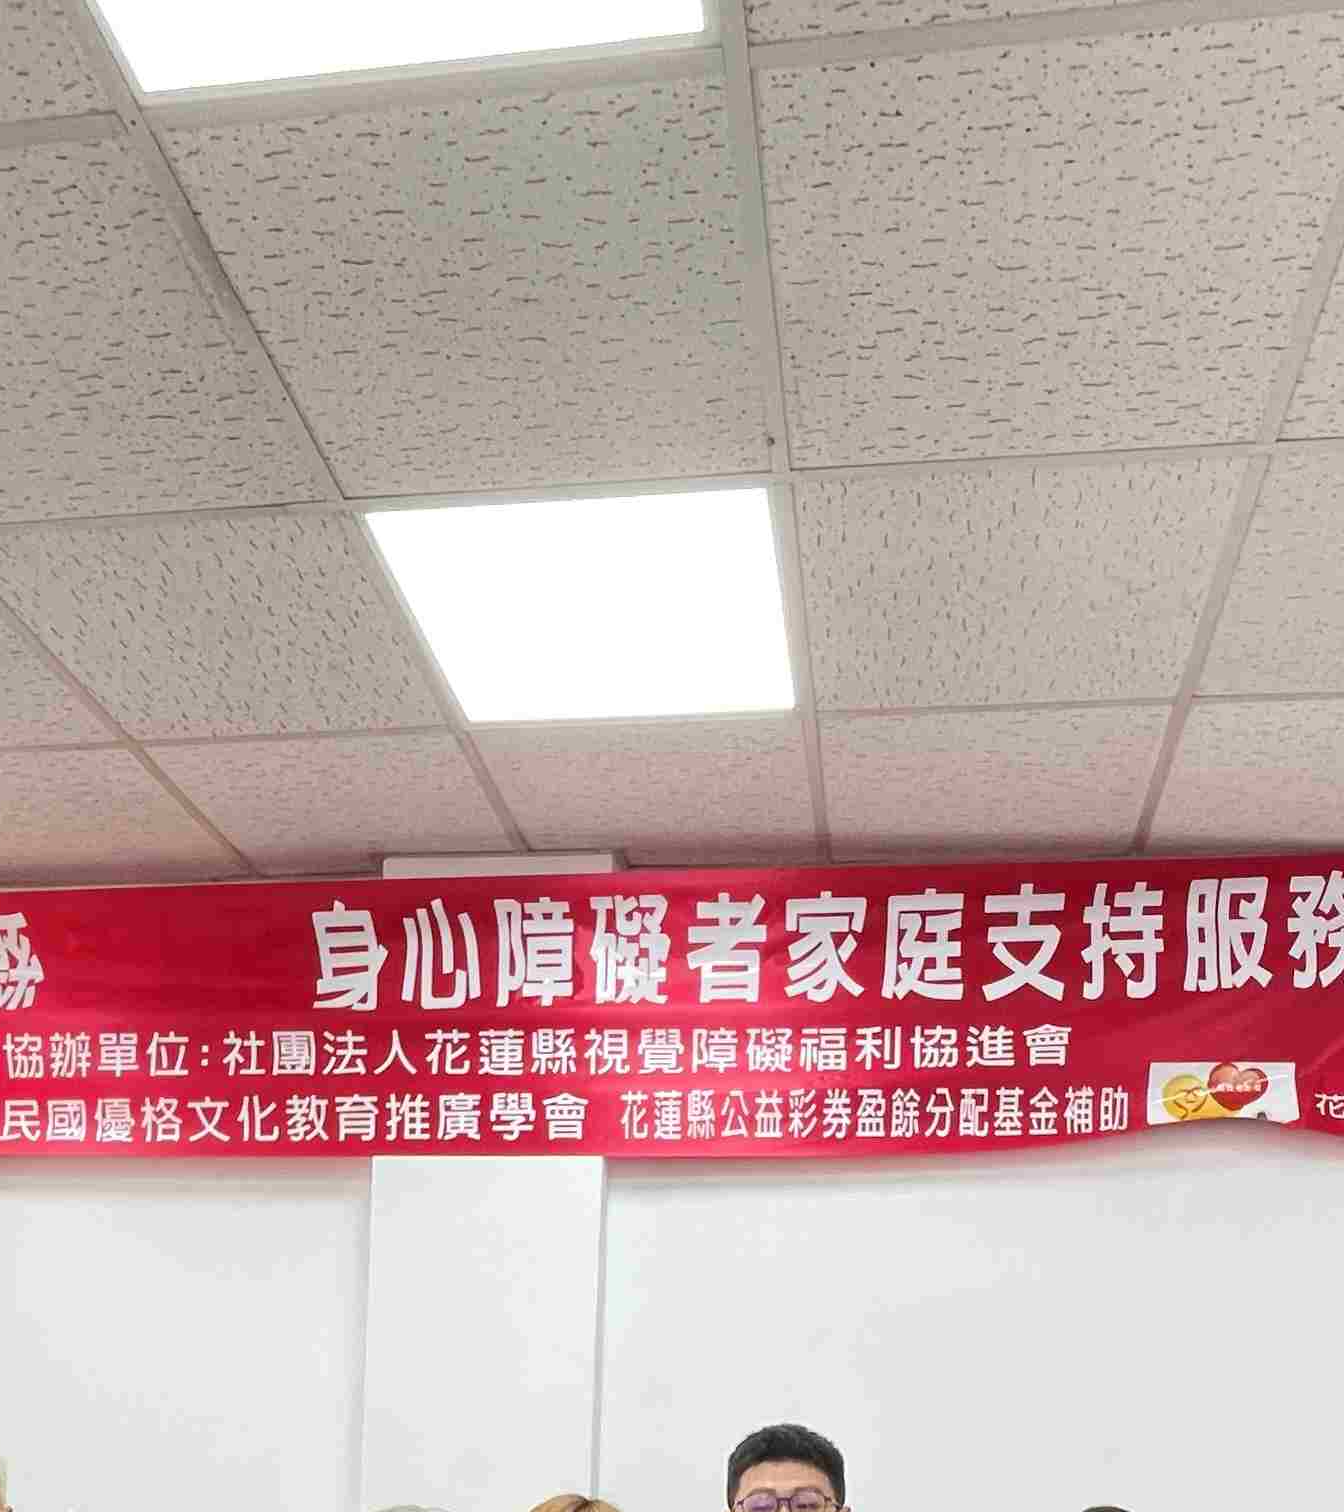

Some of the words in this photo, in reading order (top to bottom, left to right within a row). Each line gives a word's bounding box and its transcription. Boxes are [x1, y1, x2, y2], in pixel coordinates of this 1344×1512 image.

[619, 1085, 1130, 1142] 花蓮縣公益彩券盈餘分配基金補助
